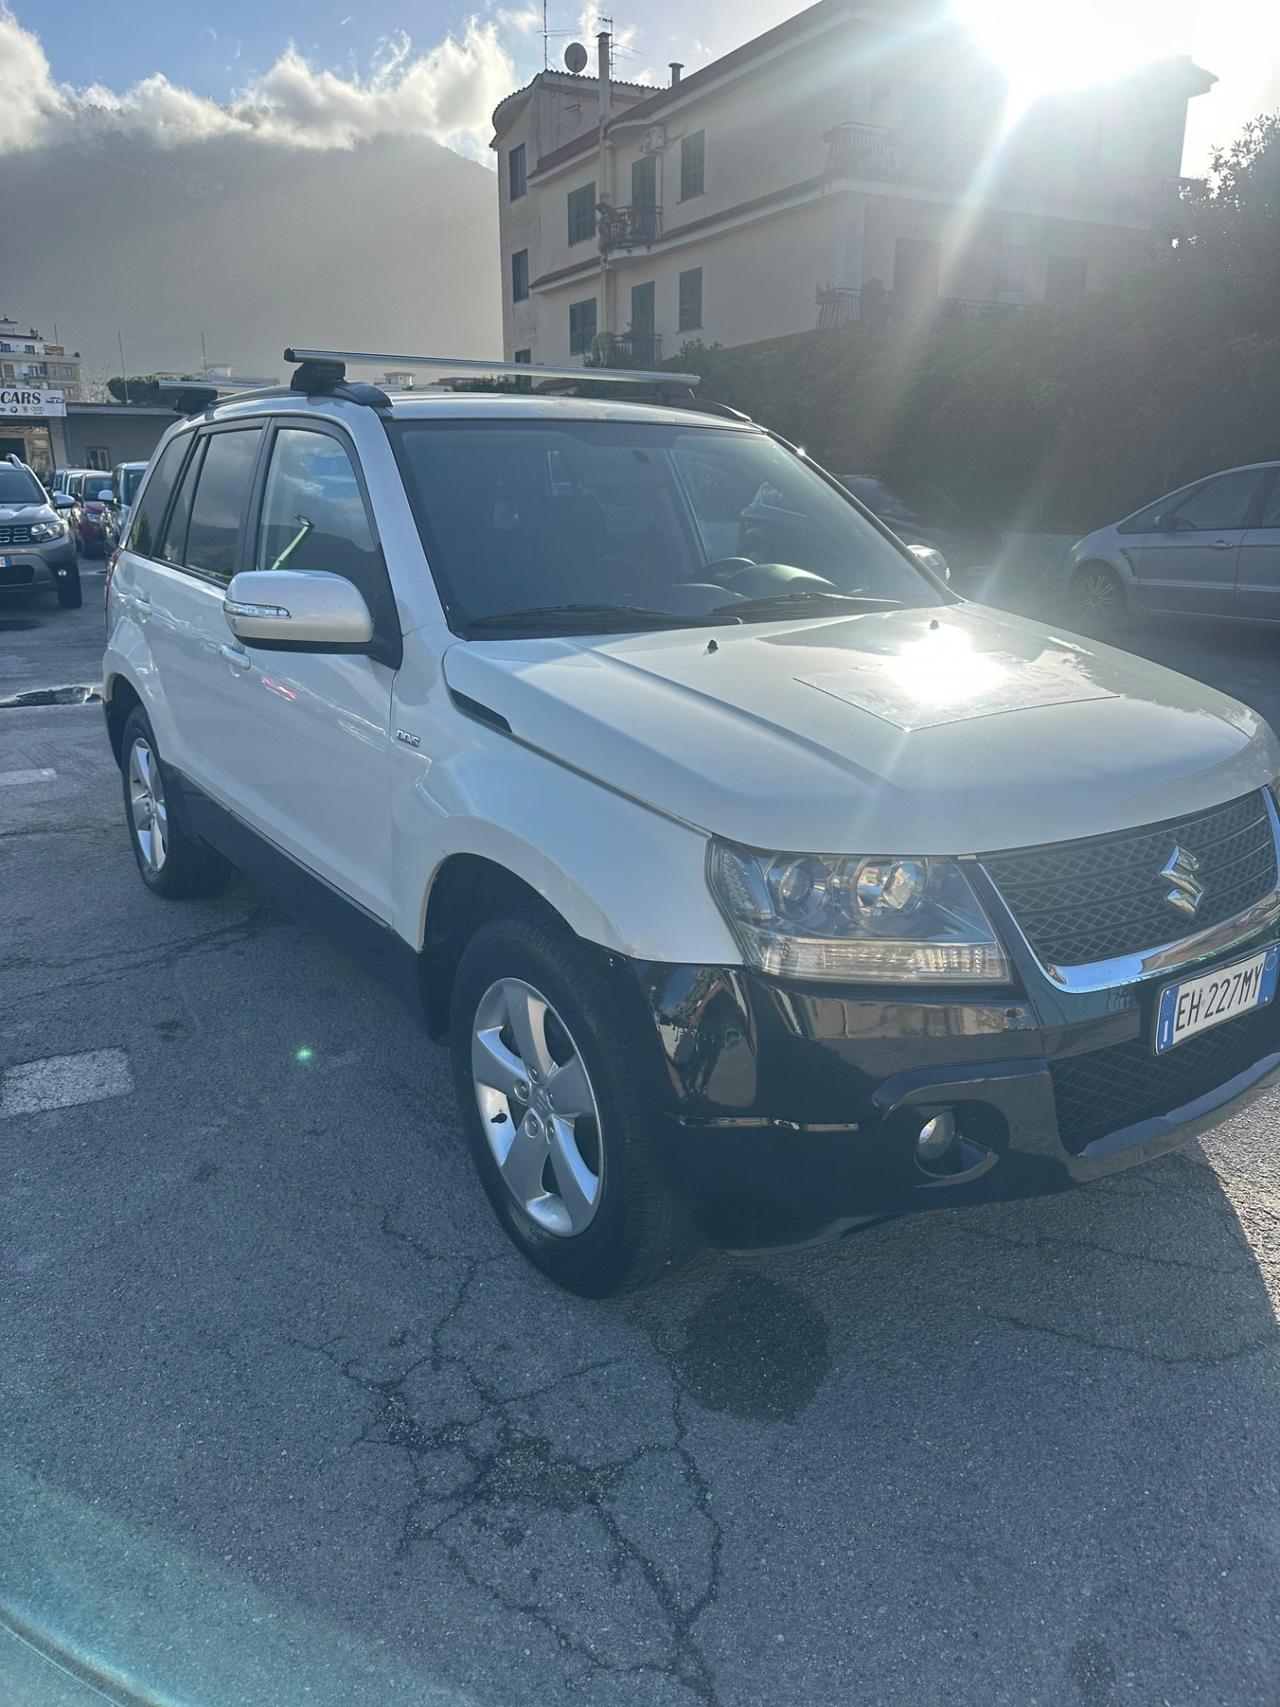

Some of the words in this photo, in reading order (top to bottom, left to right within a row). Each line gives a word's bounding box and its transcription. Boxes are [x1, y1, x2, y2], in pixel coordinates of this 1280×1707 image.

[0, 391, 41, 405] CARS
[1175, 988, 1203, 1032] EH
[1203, 963, 1263, 1019] 227MY
